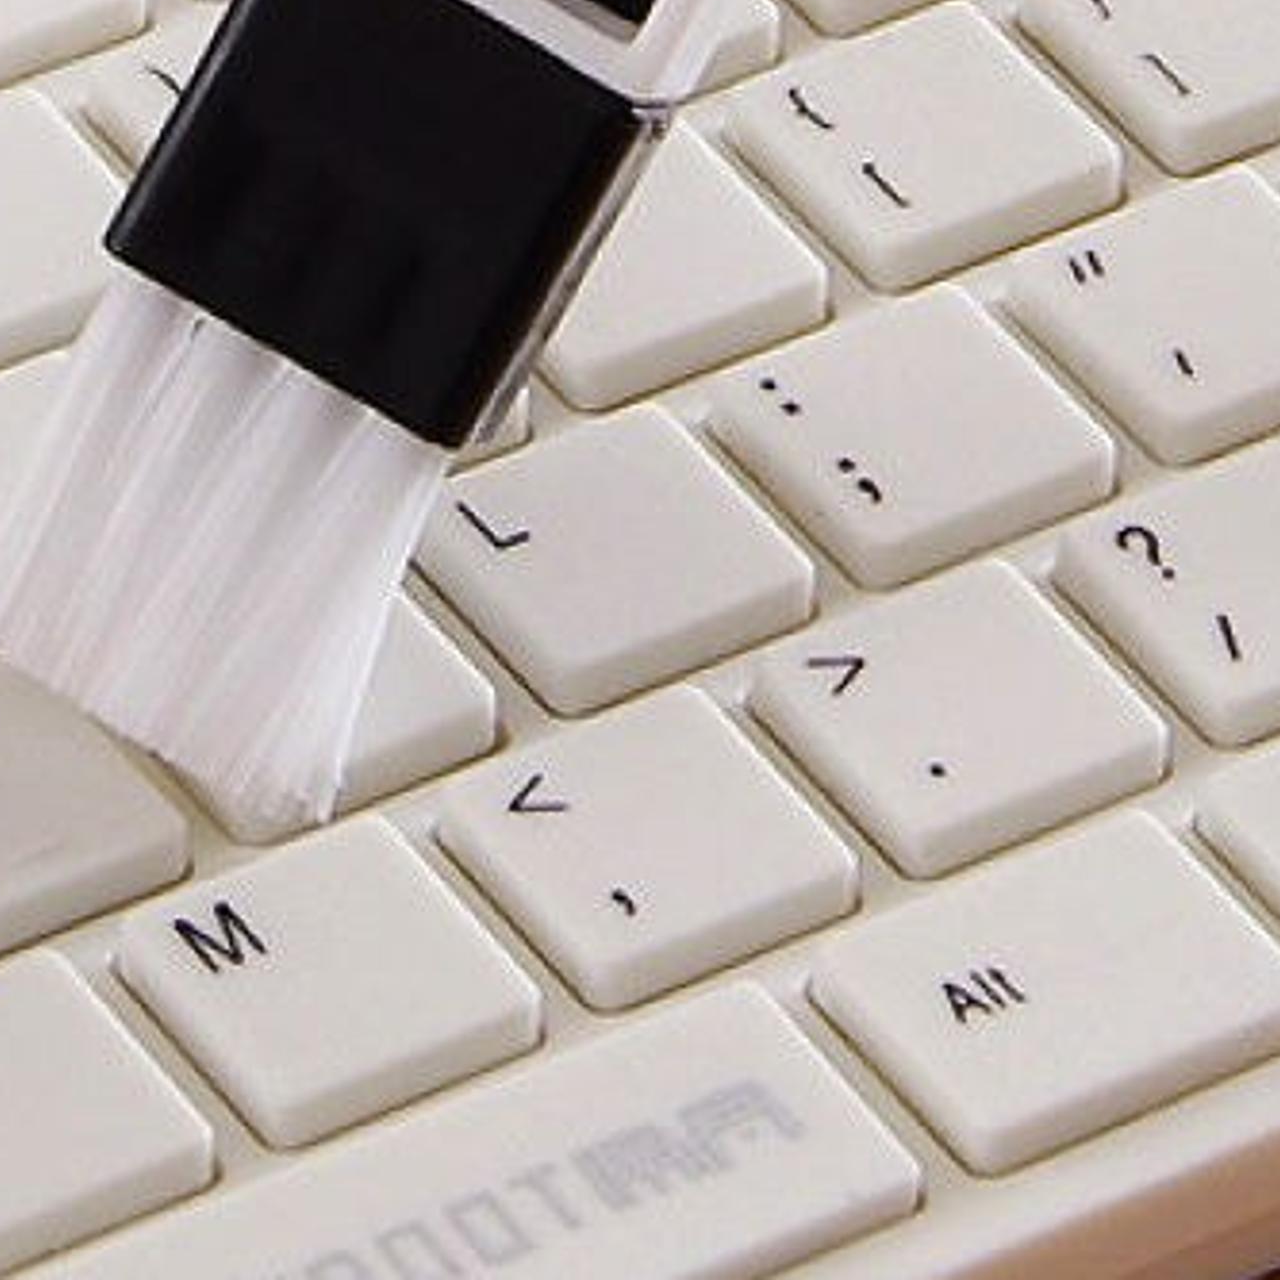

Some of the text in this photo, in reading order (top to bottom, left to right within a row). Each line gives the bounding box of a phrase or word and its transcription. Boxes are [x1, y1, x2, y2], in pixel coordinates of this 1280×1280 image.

[455, 501, 531, 551] L
[1114, 525, 1175, 580] ?
[173, 901, 268, 974] M
[941, 967, 1025, 1024] Alt
